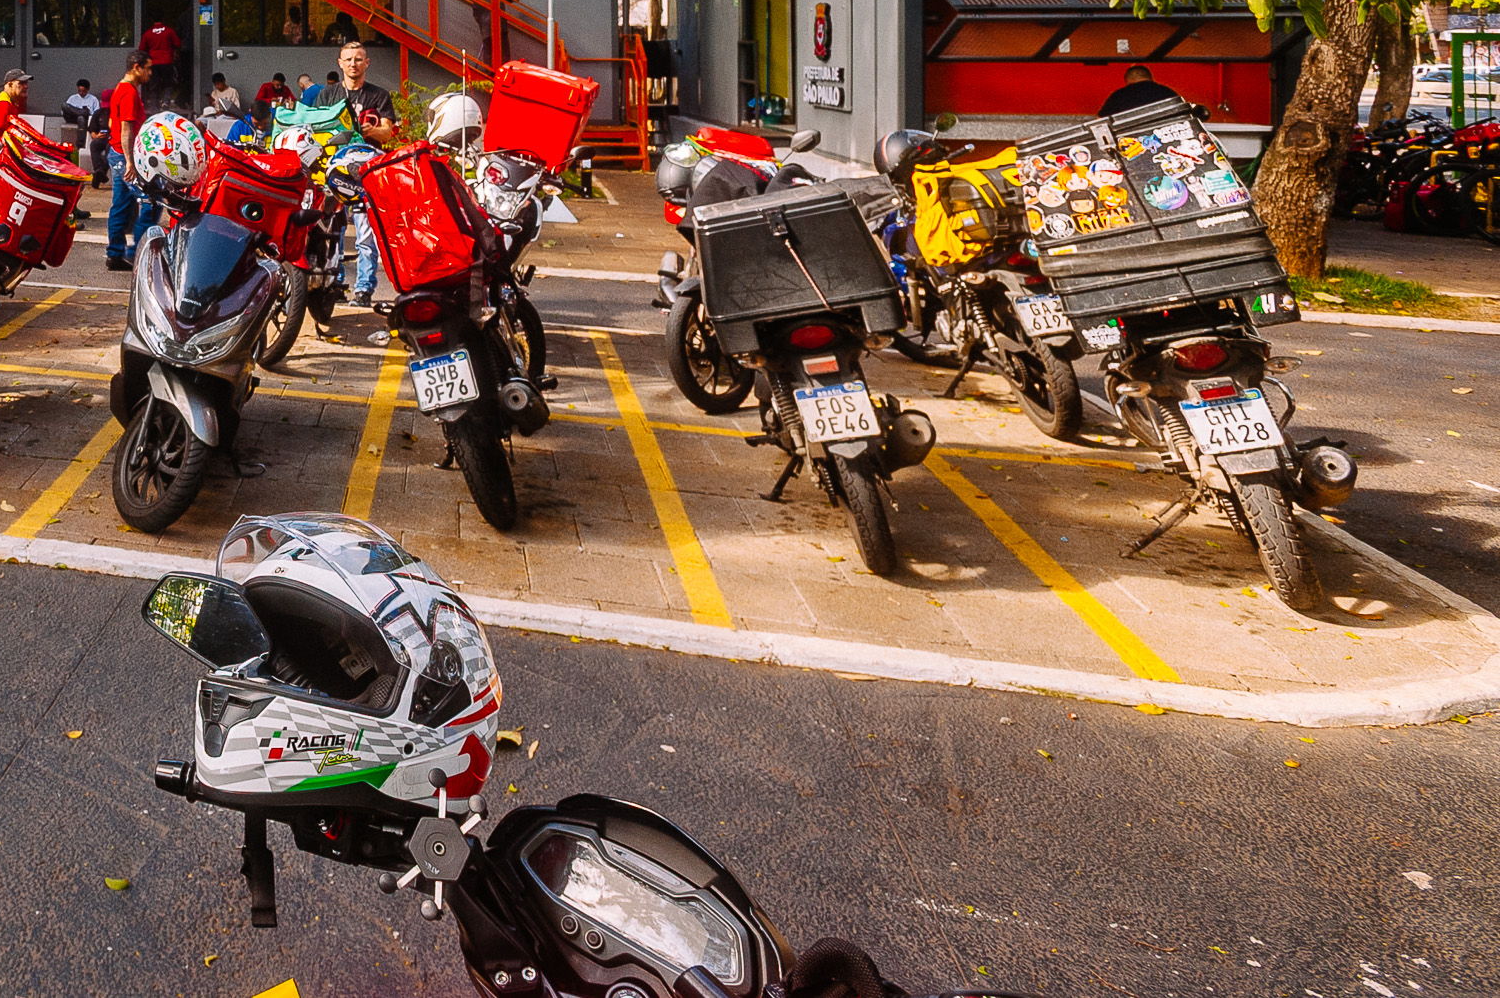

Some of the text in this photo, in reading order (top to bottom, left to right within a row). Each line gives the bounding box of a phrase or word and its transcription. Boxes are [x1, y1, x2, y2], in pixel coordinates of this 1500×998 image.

[803, 81, 840, 106] SÃO PAULO
[14, 192, 33, 206] CAMISA
[7, 201, 27, 226] 9
[181, 297, 202, 307] HONDA
[428, 359, 450, 368] BRASIL
[426, 365, 459, 385] SWB
[424, 379, 468, 404] 9F76
[816, 389, 843, 397] BRASIL
[815, 395, 856, 417] FOS
[1204, 403, 1251, 426] GHI
[815, 413, 870, 436] 9E46
[1209, 422, 1270, 448] 4A28
[286, 734, 347, 751] RACING
